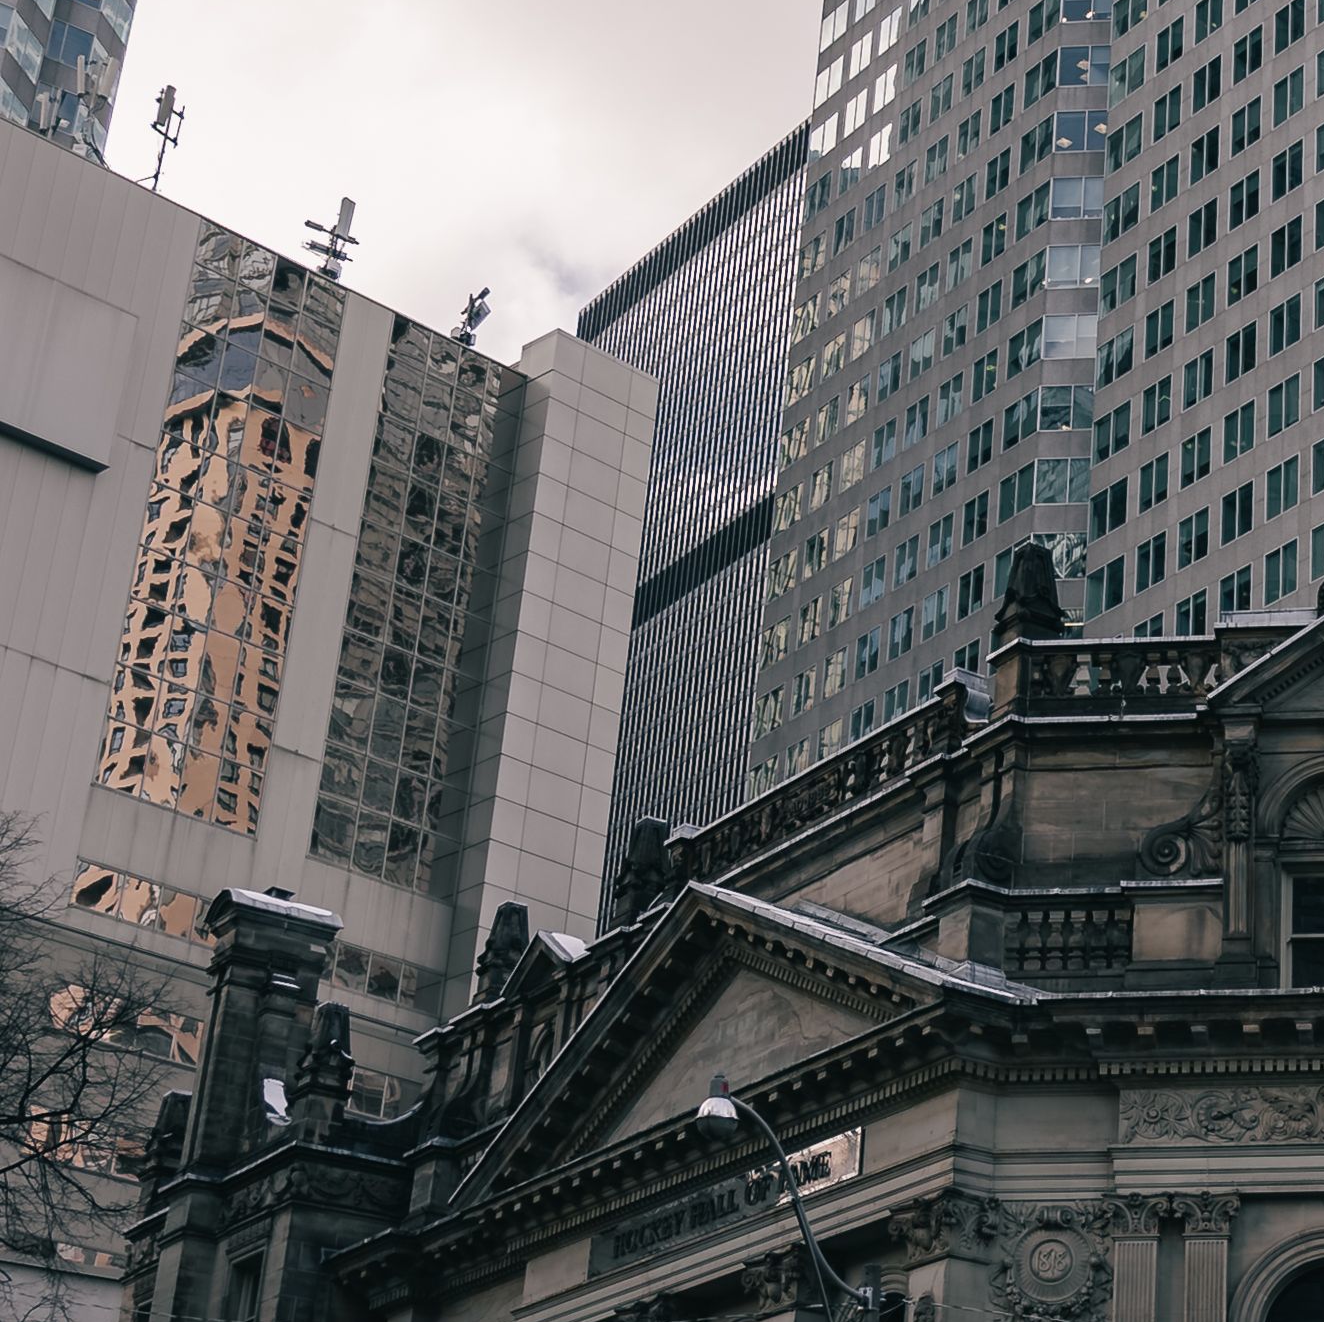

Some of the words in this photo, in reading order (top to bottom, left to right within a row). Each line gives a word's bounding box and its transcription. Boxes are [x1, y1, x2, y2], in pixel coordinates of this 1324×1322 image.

[613, 1209, 686, 1259] HOCKEY
[689, 1189, 739, 1229] HALL
[744, 1173, 774, 1206] OF
